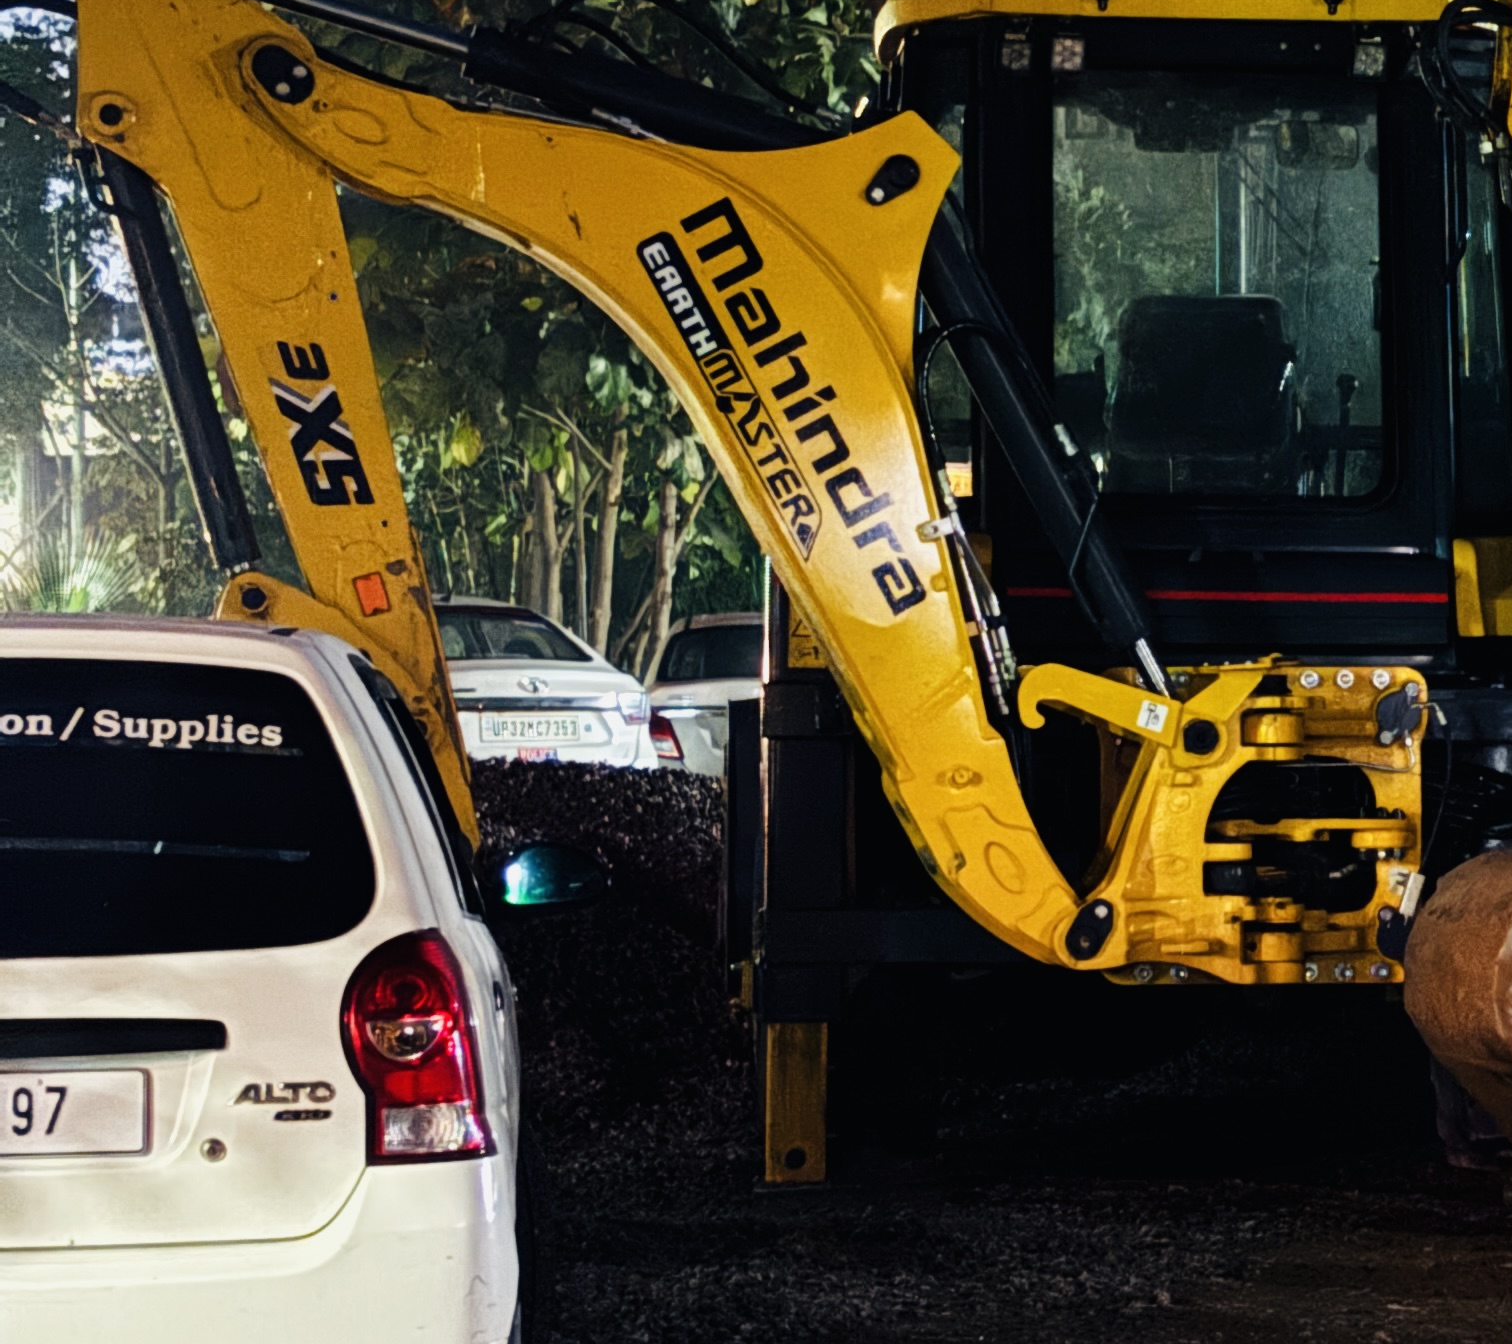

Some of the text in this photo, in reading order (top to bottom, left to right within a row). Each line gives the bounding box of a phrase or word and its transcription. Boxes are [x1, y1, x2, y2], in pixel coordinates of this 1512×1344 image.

[680, 197, 926, 616] Mahindra
[0, 713, 54, 736] on
[93, 709, 283, 749] Supplies
[11, 1086, 68, 1137] 97
[230, 1080, 337, 1106] ALTO
